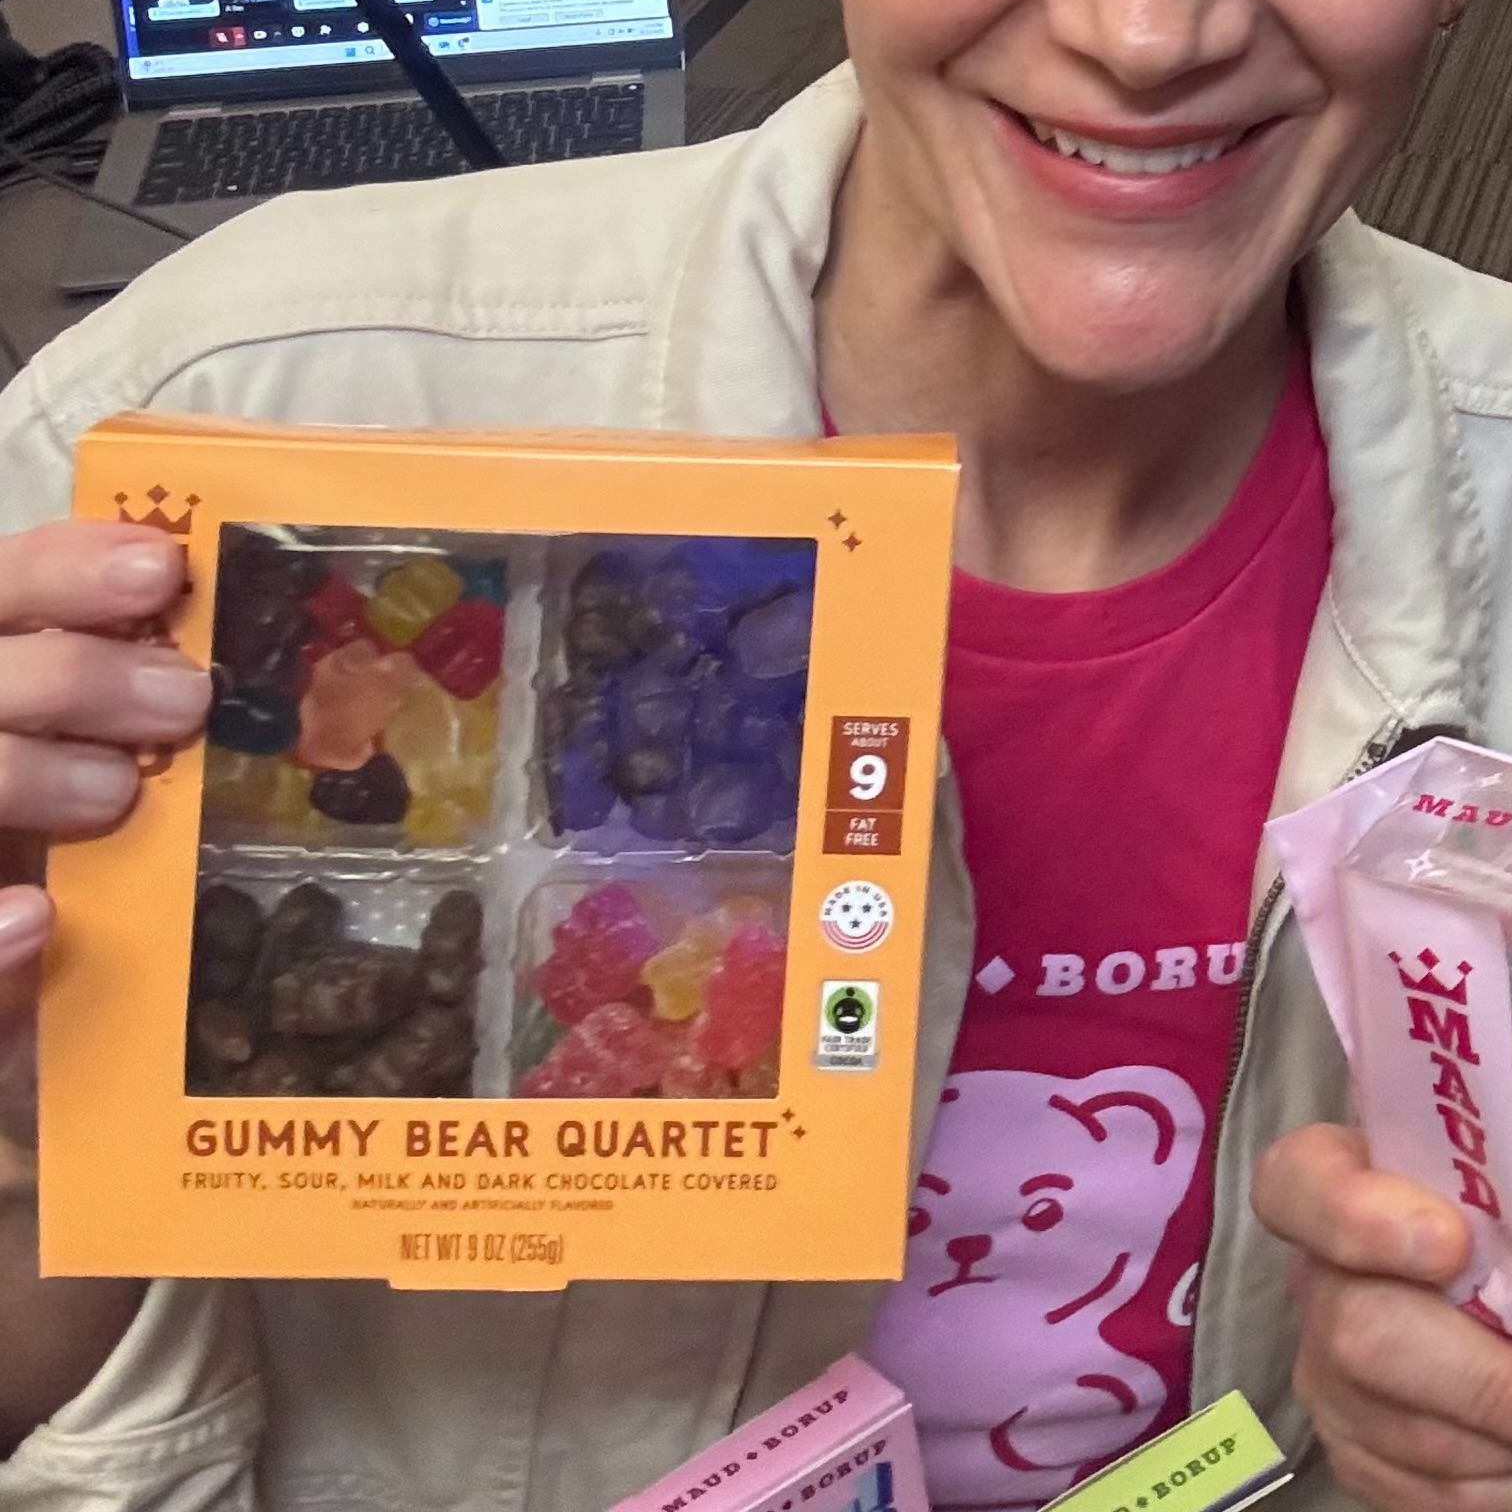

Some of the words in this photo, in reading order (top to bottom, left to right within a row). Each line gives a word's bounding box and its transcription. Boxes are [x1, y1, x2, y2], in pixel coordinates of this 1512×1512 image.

[843, 722, 899, 737] SERVES
[849, 754, 888, 801] 9
[844, 832, 880, 847] FREE
[850, 818, 877, 832] FAT
[824, 886, 850, 916] MADE
[856, 885, 871, 894] IN
[873, 893, 889, 918] USA
[186, 1119, 380, 1157] GUMMY
[406, 1119, 530, 1158] BEAR
[556, 1119, 778, 1158] QUARTET
[181, 1172, 267, 1191] FRUITY,
[279, 1172, 346, 1191] SOUR,
[358, 1173, 411, 1190] MILK
[421, 1173, 466, 1190] AND
[478, 1173, 536, 1190] DARK
[546, 1173, 672, 1191] CHOCOLATE
[682, 1173, 778, 1191] COVERED
[400, 1233, 432, 1261] NET
[436, 1233, 463, 1261] WT
[468, 1233, 479, 1261] 9
[483, 1233, 507, 1262] OZ
[509, 1233, 564, 1266] (255g)
[661, 1461, 741, 1512] MAUD
[761, 1389, 849, 1451] BORUP
[799, 1439, 887, 1503] BORUP
[1151, 1436, 1237, 1500] BORUP
